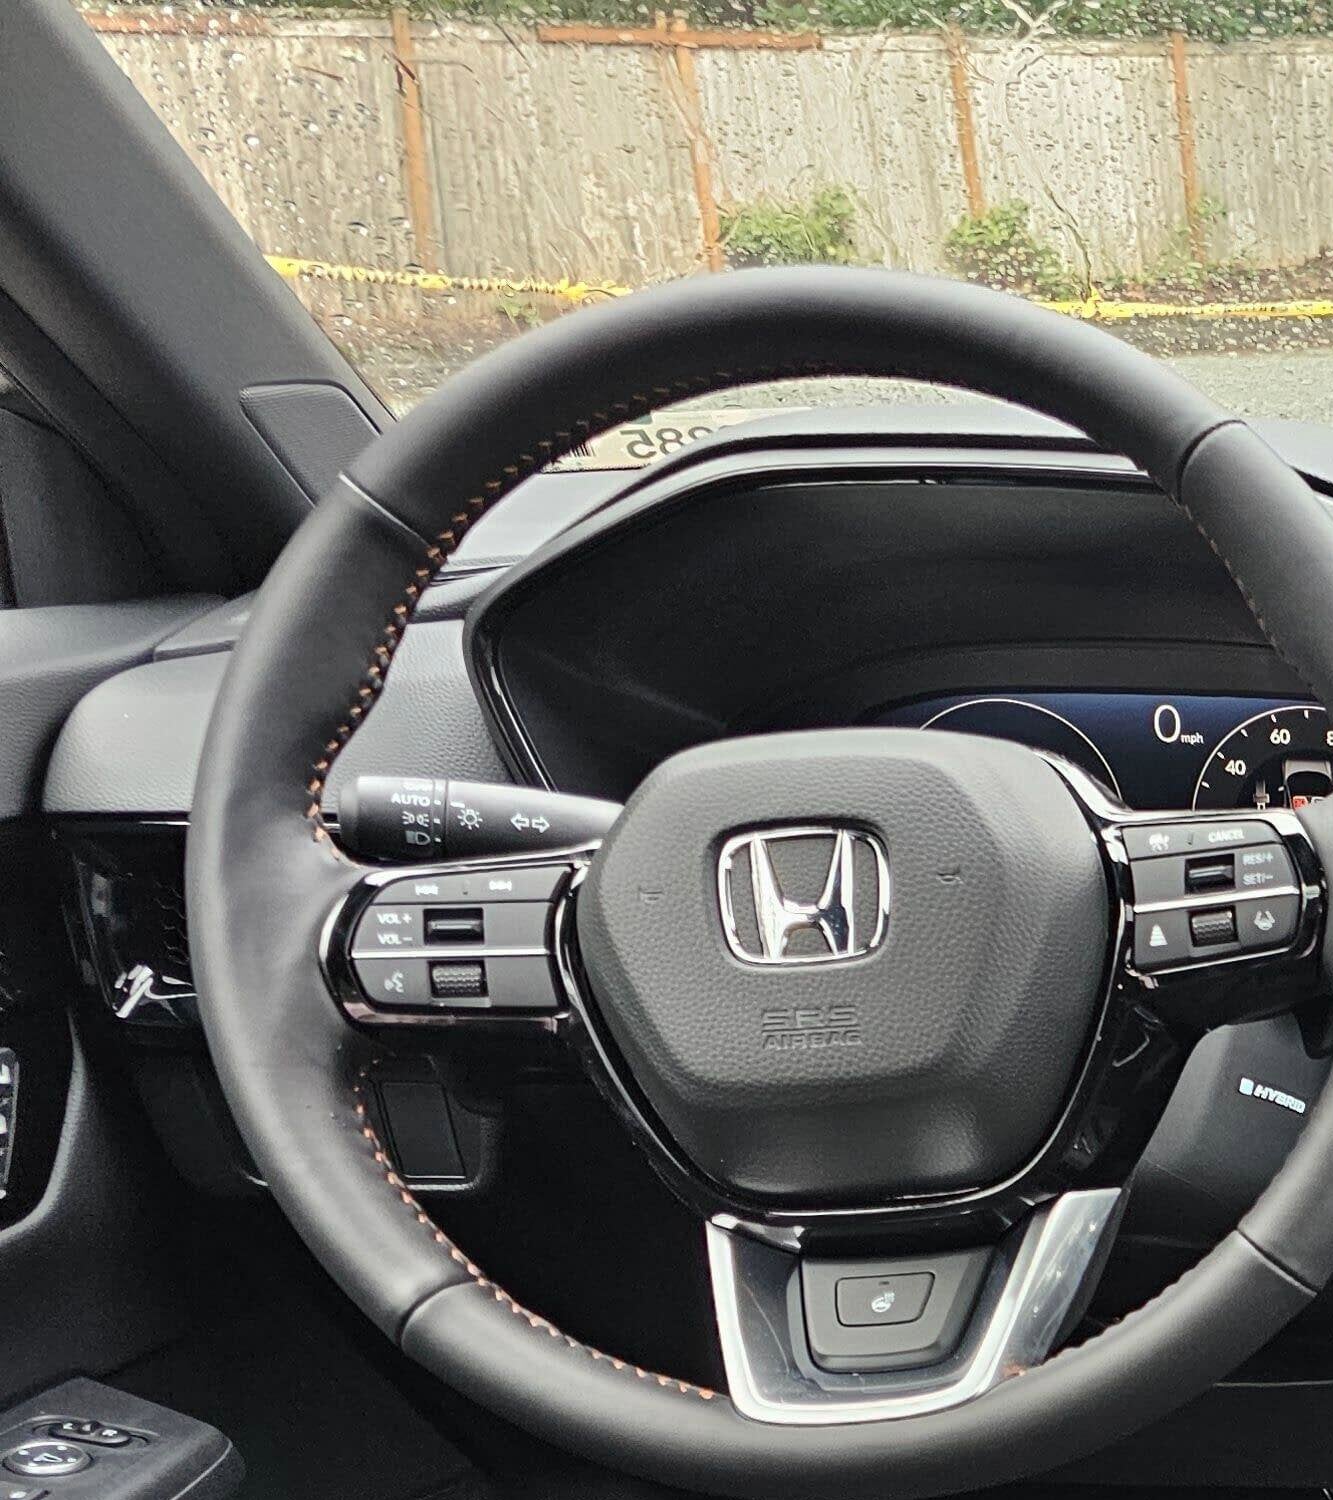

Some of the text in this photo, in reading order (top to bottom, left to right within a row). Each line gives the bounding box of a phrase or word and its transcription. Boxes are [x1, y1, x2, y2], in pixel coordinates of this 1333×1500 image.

[1153, 704, 1204, 745] 0 mph
[1270, 728, 1291, 745] 60
[1225, 759, 1247, 776] 40
[391, 792, 431, 807] AUTO
[1207, 829, 1245, 844] CANCEL
[377, 913, 402, 925] VOL
[377, 933, 402, 945] VOL
[761, 1005, 858, 1028] SRS
